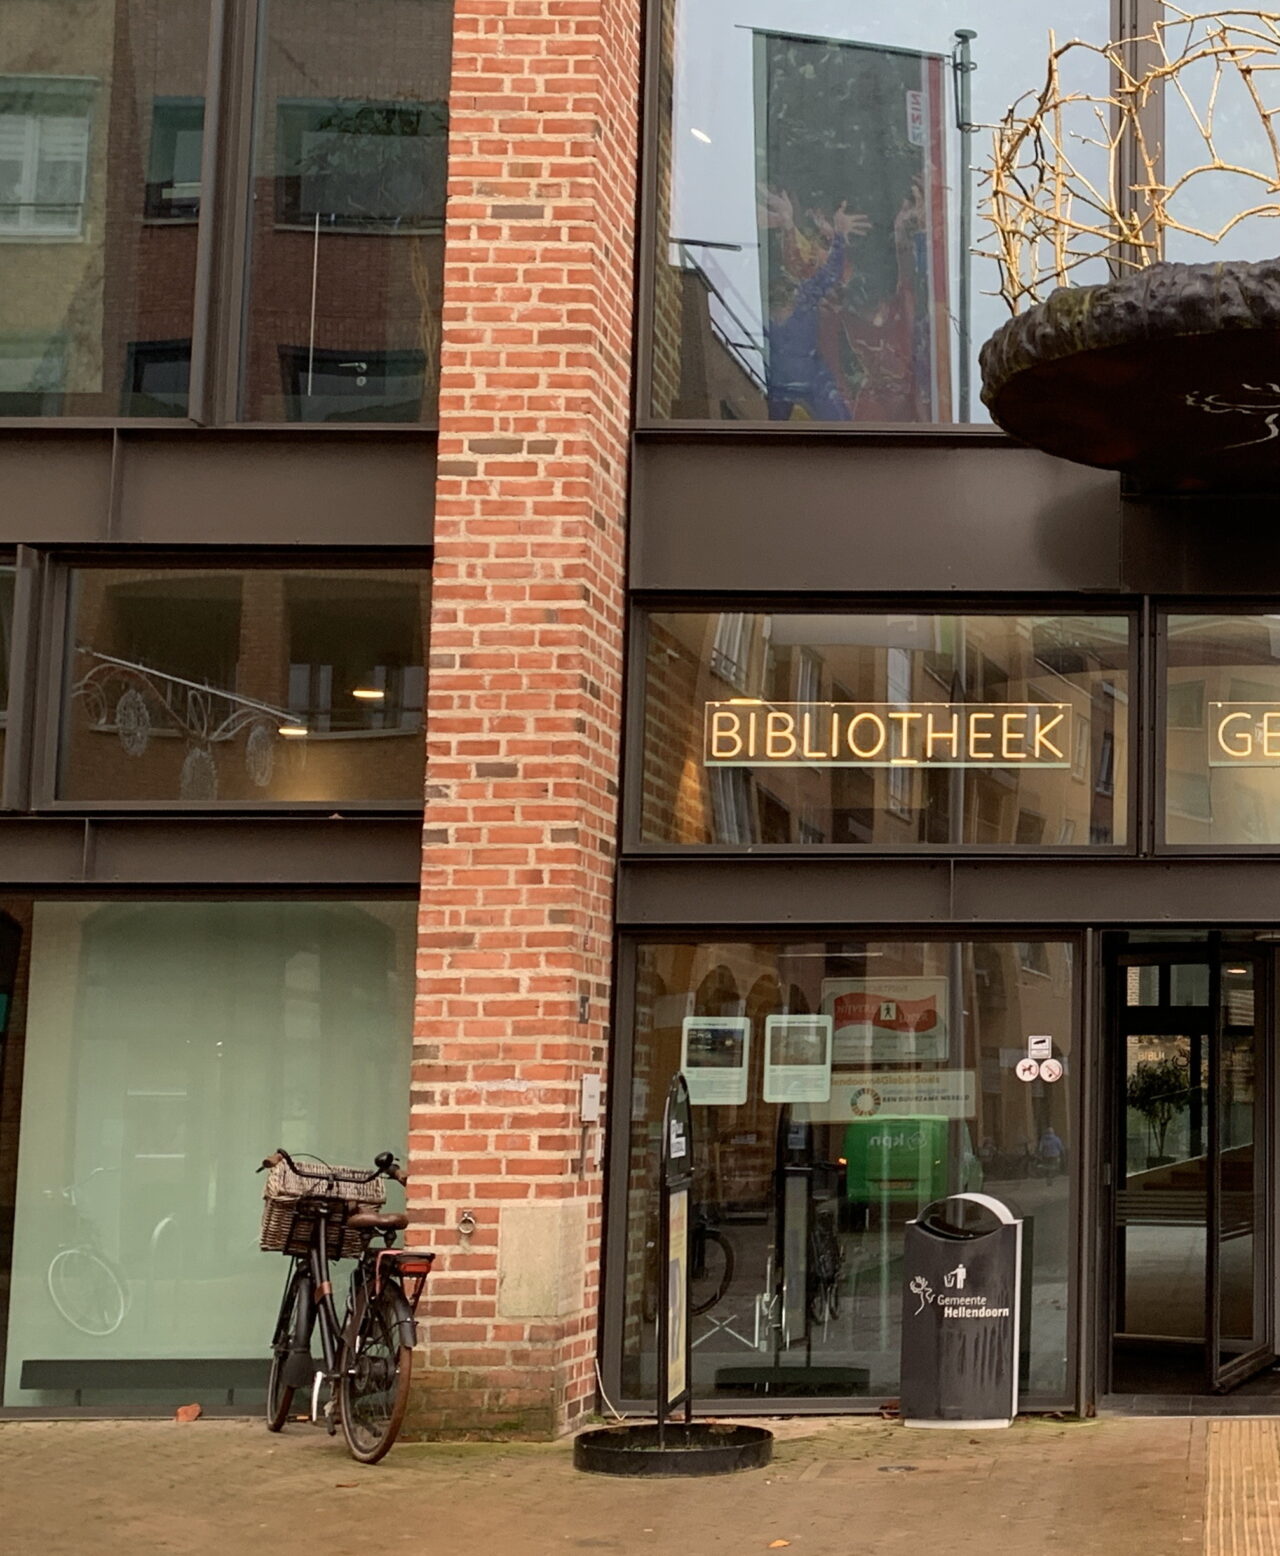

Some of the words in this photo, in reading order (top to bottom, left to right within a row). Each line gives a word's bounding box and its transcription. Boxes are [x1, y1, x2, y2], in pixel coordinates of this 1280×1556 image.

[710, 711, 1064, 759] BIBLIOTHEEK
[937, 1294, 988, 1306] Gemeente
[944, 1306, 1010, 1318] Hellendoorn
